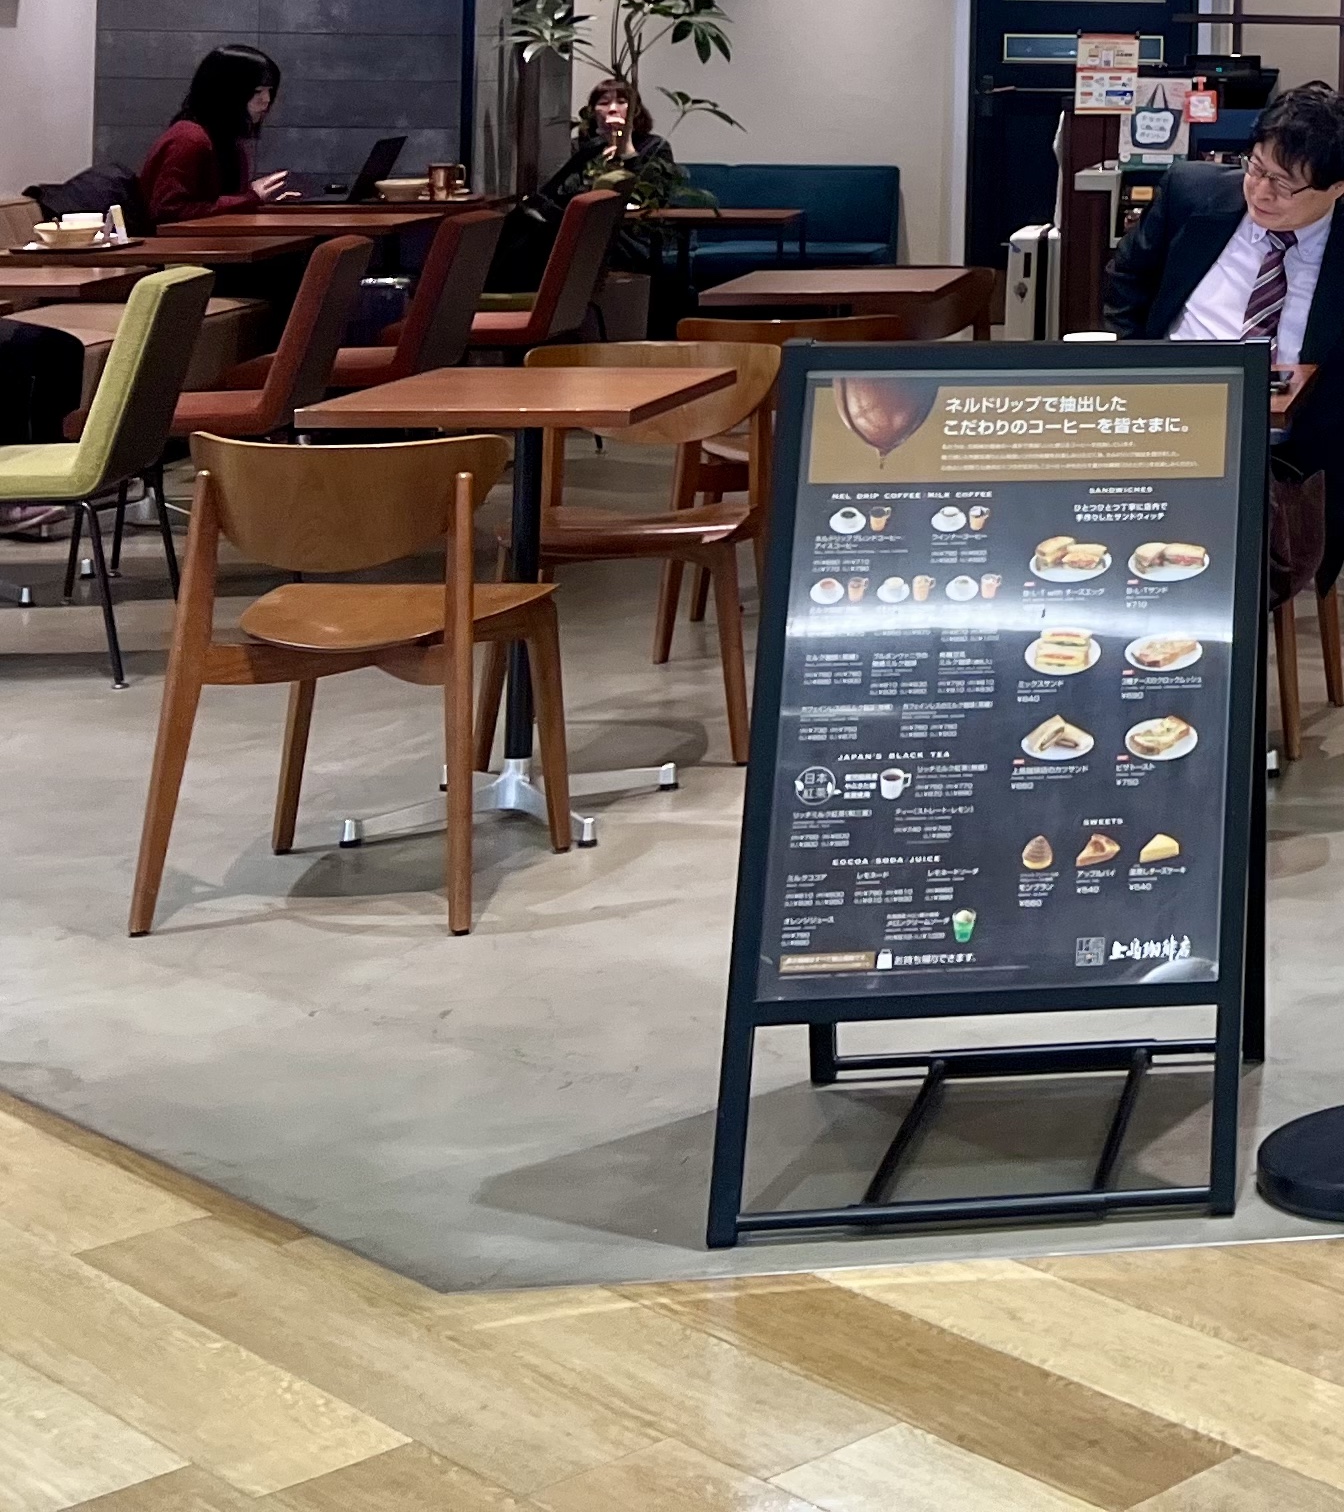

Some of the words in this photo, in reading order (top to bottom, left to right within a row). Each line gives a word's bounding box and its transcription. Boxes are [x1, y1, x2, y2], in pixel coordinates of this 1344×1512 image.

[945, 395, 1127, 414] ネルドリップで抽出した
[943, 417, 1189, 436] こだわりのコーヒーを皆さまに。
[883, 491, 921, 500] COFFEE
[955, 490, 993, 498] COFFEE
[930, 750, 950, 759] TEA
[804, 772, 827, 785] 日本
[1082, 818, 1124, 826] SWEETS
[1108, 934, 1191, 962] 上島珈琲店
